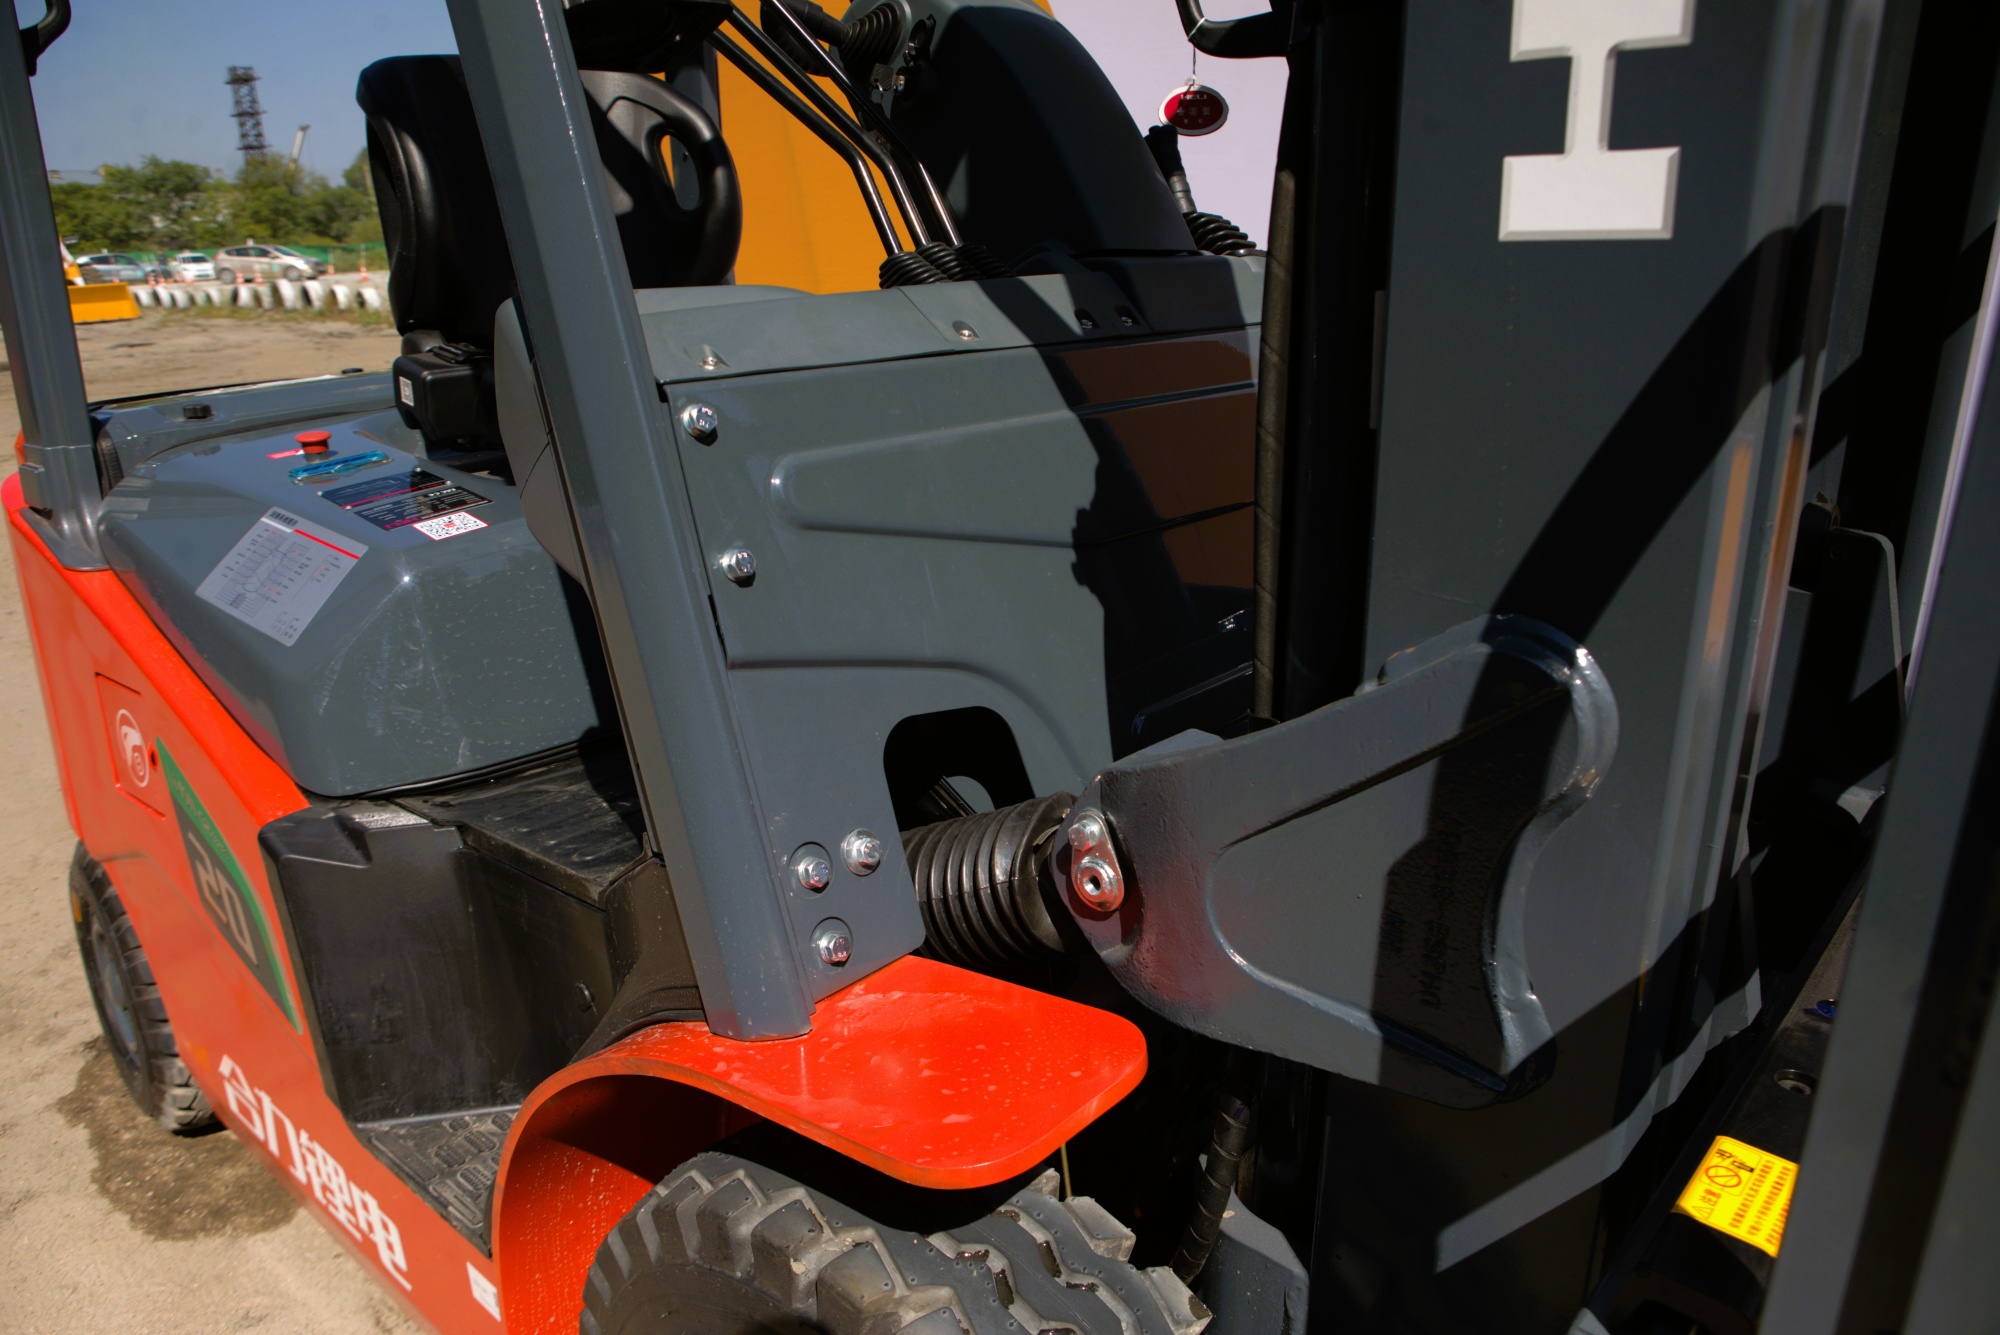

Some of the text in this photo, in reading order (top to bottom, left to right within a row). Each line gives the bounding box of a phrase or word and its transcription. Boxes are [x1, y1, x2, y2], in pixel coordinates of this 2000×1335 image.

[187, 831, 258, 966] 20
[218, 1054, 413, 1292] 合力锂电
